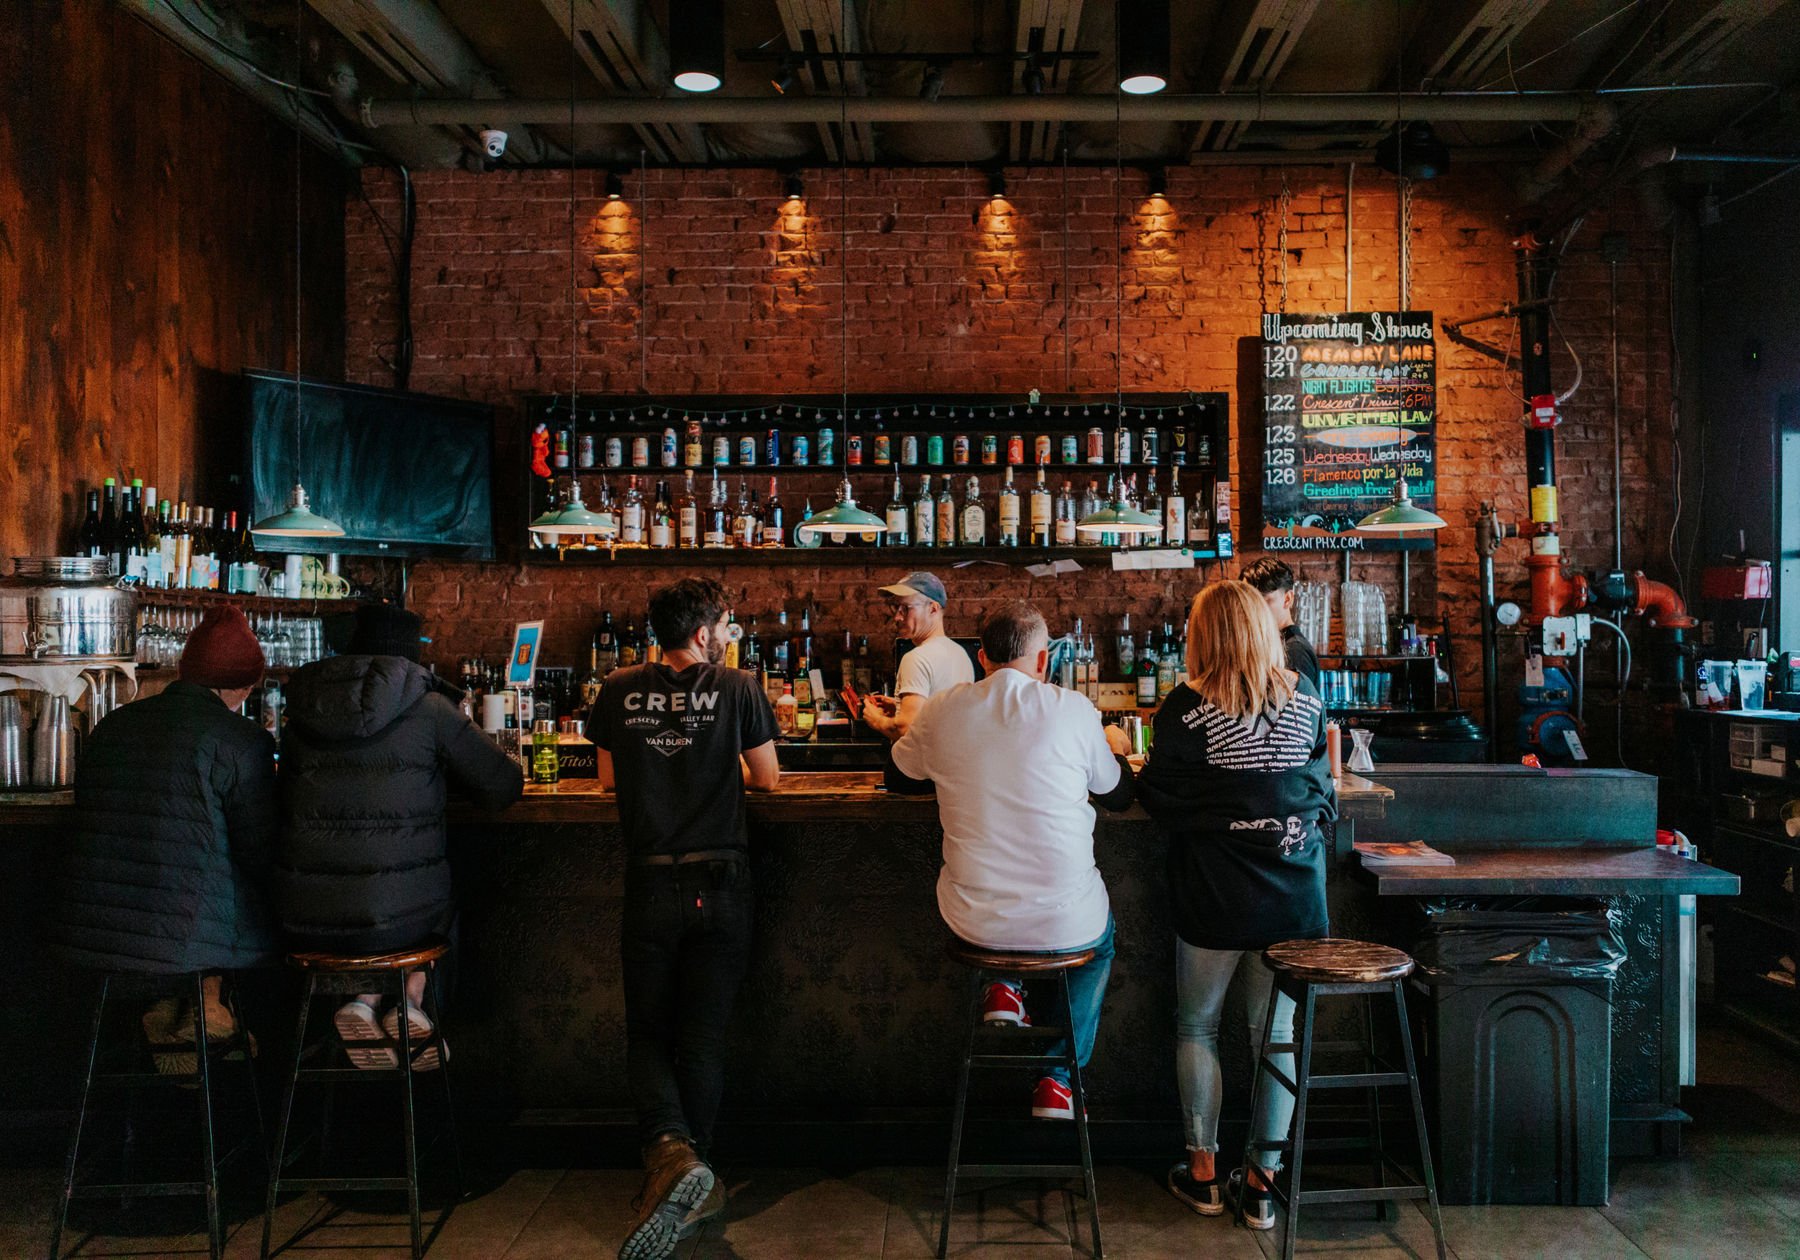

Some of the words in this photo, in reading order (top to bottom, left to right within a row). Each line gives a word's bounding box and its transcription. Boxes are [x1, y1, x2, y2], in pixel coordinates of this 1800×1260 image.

[1263, 314, 1363, 347] Upcoming
[1366, 312, 1433, 342] Shows
[1302, 345, 1384, 362] MEMORY
[1389, 345, 1434, 361] LANE
[1302, 380, 1327, 395] NIGHT
[1303, 394, 1360, 410] Crescent
[1302, 411, 1399, 428] UNWRITTEN
[1400, 410, 1433, 424] LAW
[1302, 448, 1370, 466] Wednesday
[1303, 468, 1361, 483] Flamenco
[1362, 467, 1383, 483] por
[1383, 464, 1396, 479] la
[1303, 482, 1362, 499] Greetings
[623, 690, 719, 711] CREW
[1182, 708, 1199, 724] Call
[645, 737, 664, 747] VAN
[665, 737, 693, 747] BUREN
[559, 755, 596, 768] Tito's
